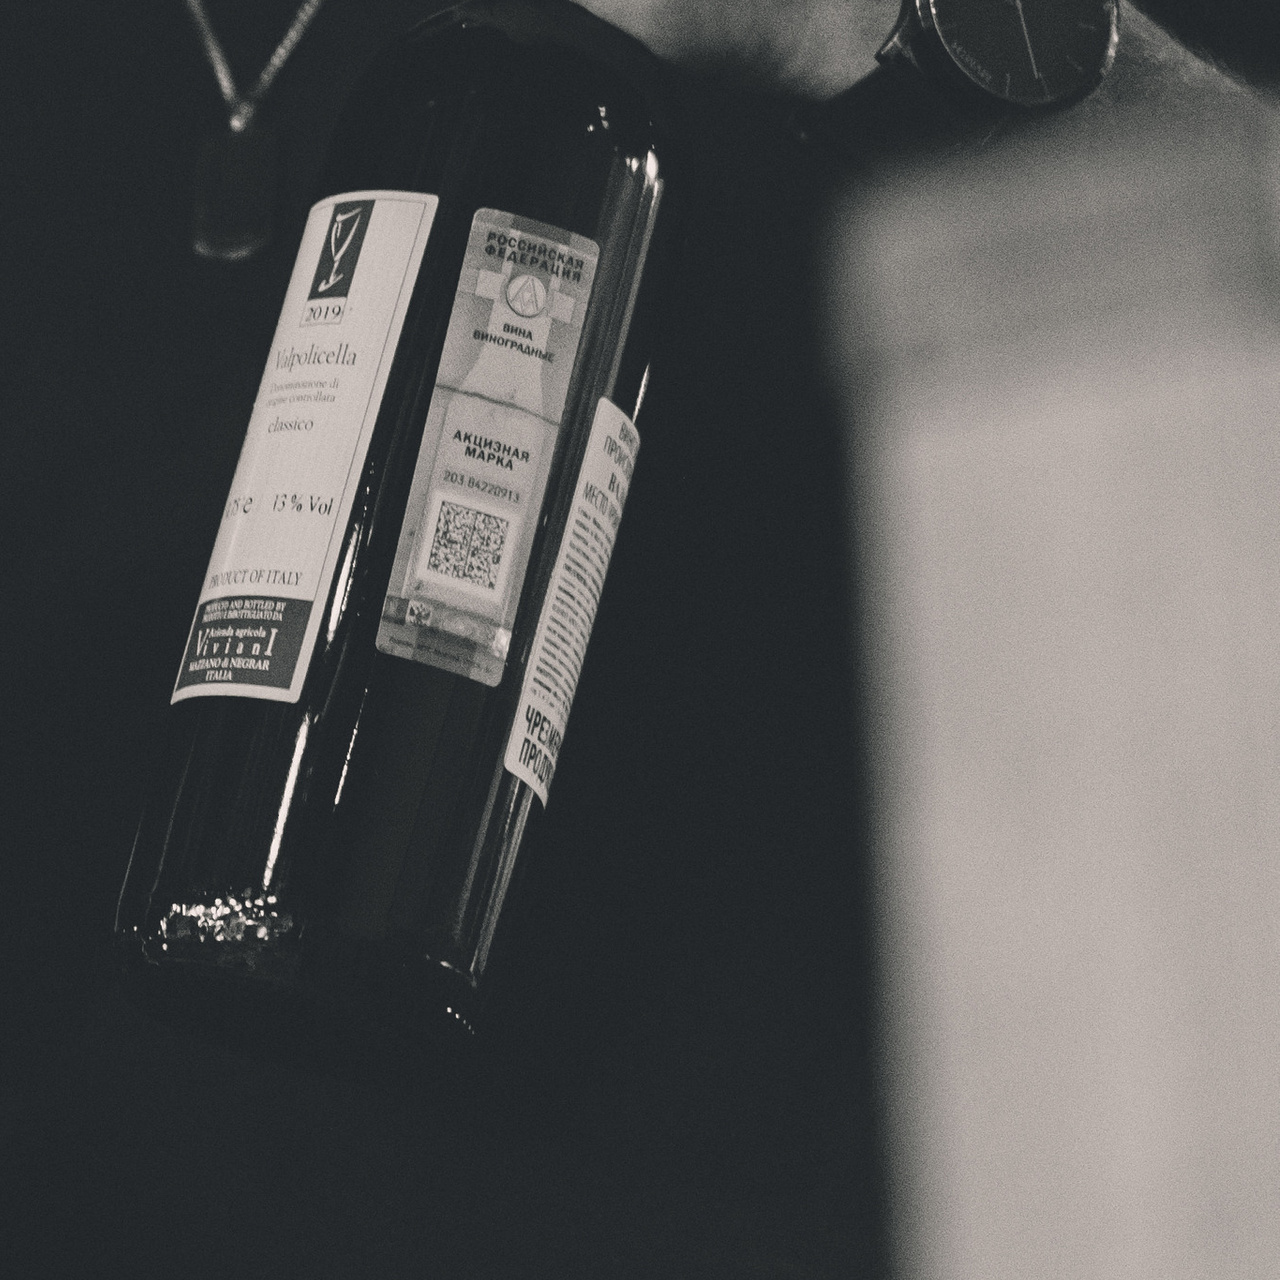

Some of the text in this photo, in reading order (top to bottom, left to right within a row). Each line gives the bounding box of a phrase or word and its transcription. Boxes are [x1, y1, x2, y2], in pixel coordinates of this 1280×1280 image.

[487, 232, 585, 270] РОССИЙСКАЯ
[484, 244, 582, 283] ФЕДЕРАЦИЯ
[305, 305, 342, 322] 2019
[503, 323, 533, 341] ВИНА
[473, 330, 555, 363] ВИНОГРАДНЫЕ
[276, 343, 357, 372] Valpolicella
[268, 416, 314, 434] classico
[453, 429, 530, 462] АКЦИЗНАЯ
[465, 446, 513, 471] МАРКА
[443, 470, 464, 486] 203
[310, 495, 334, 516] Vol
[250, 569, 264, 584] OF
[266, 569, 303, 587] ITALY
[230, 657, 270, 672] NEGRAR
[205, 669, 233, 681] ITALIA
